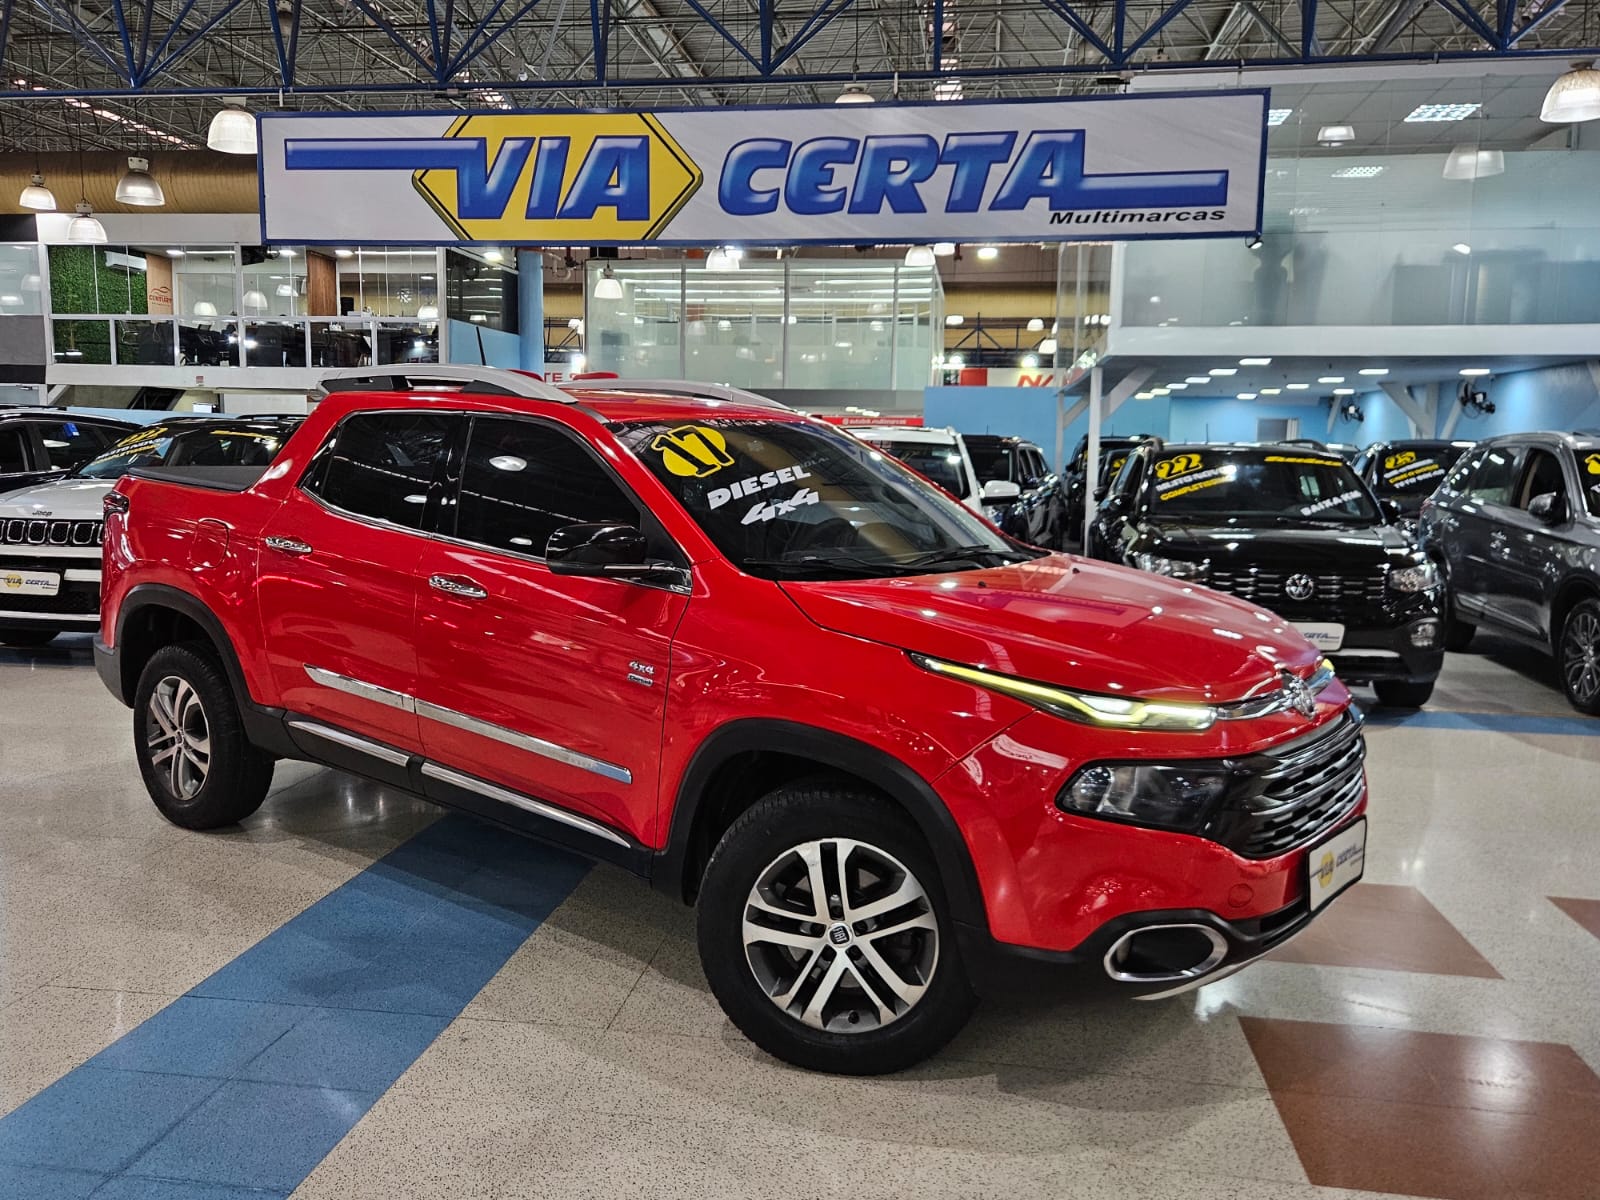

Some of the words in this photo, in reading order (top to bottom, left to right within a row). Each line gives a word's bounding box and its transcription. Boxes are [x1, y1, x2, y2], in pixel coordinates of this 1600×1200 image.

[284, 135, 651, 221] VIA
[718, 129, 1229, 216] CERTA
[1049, 209, 1226, 225] Multimarcas
[652, 426, 735, 477] 17
[1155, 453, 1203, 480] 22
[707, 465, 812, 511] DIESEL
[741, 488, 820, 526] 4x4
[1301, 496, 1342, 516] BAIXA
